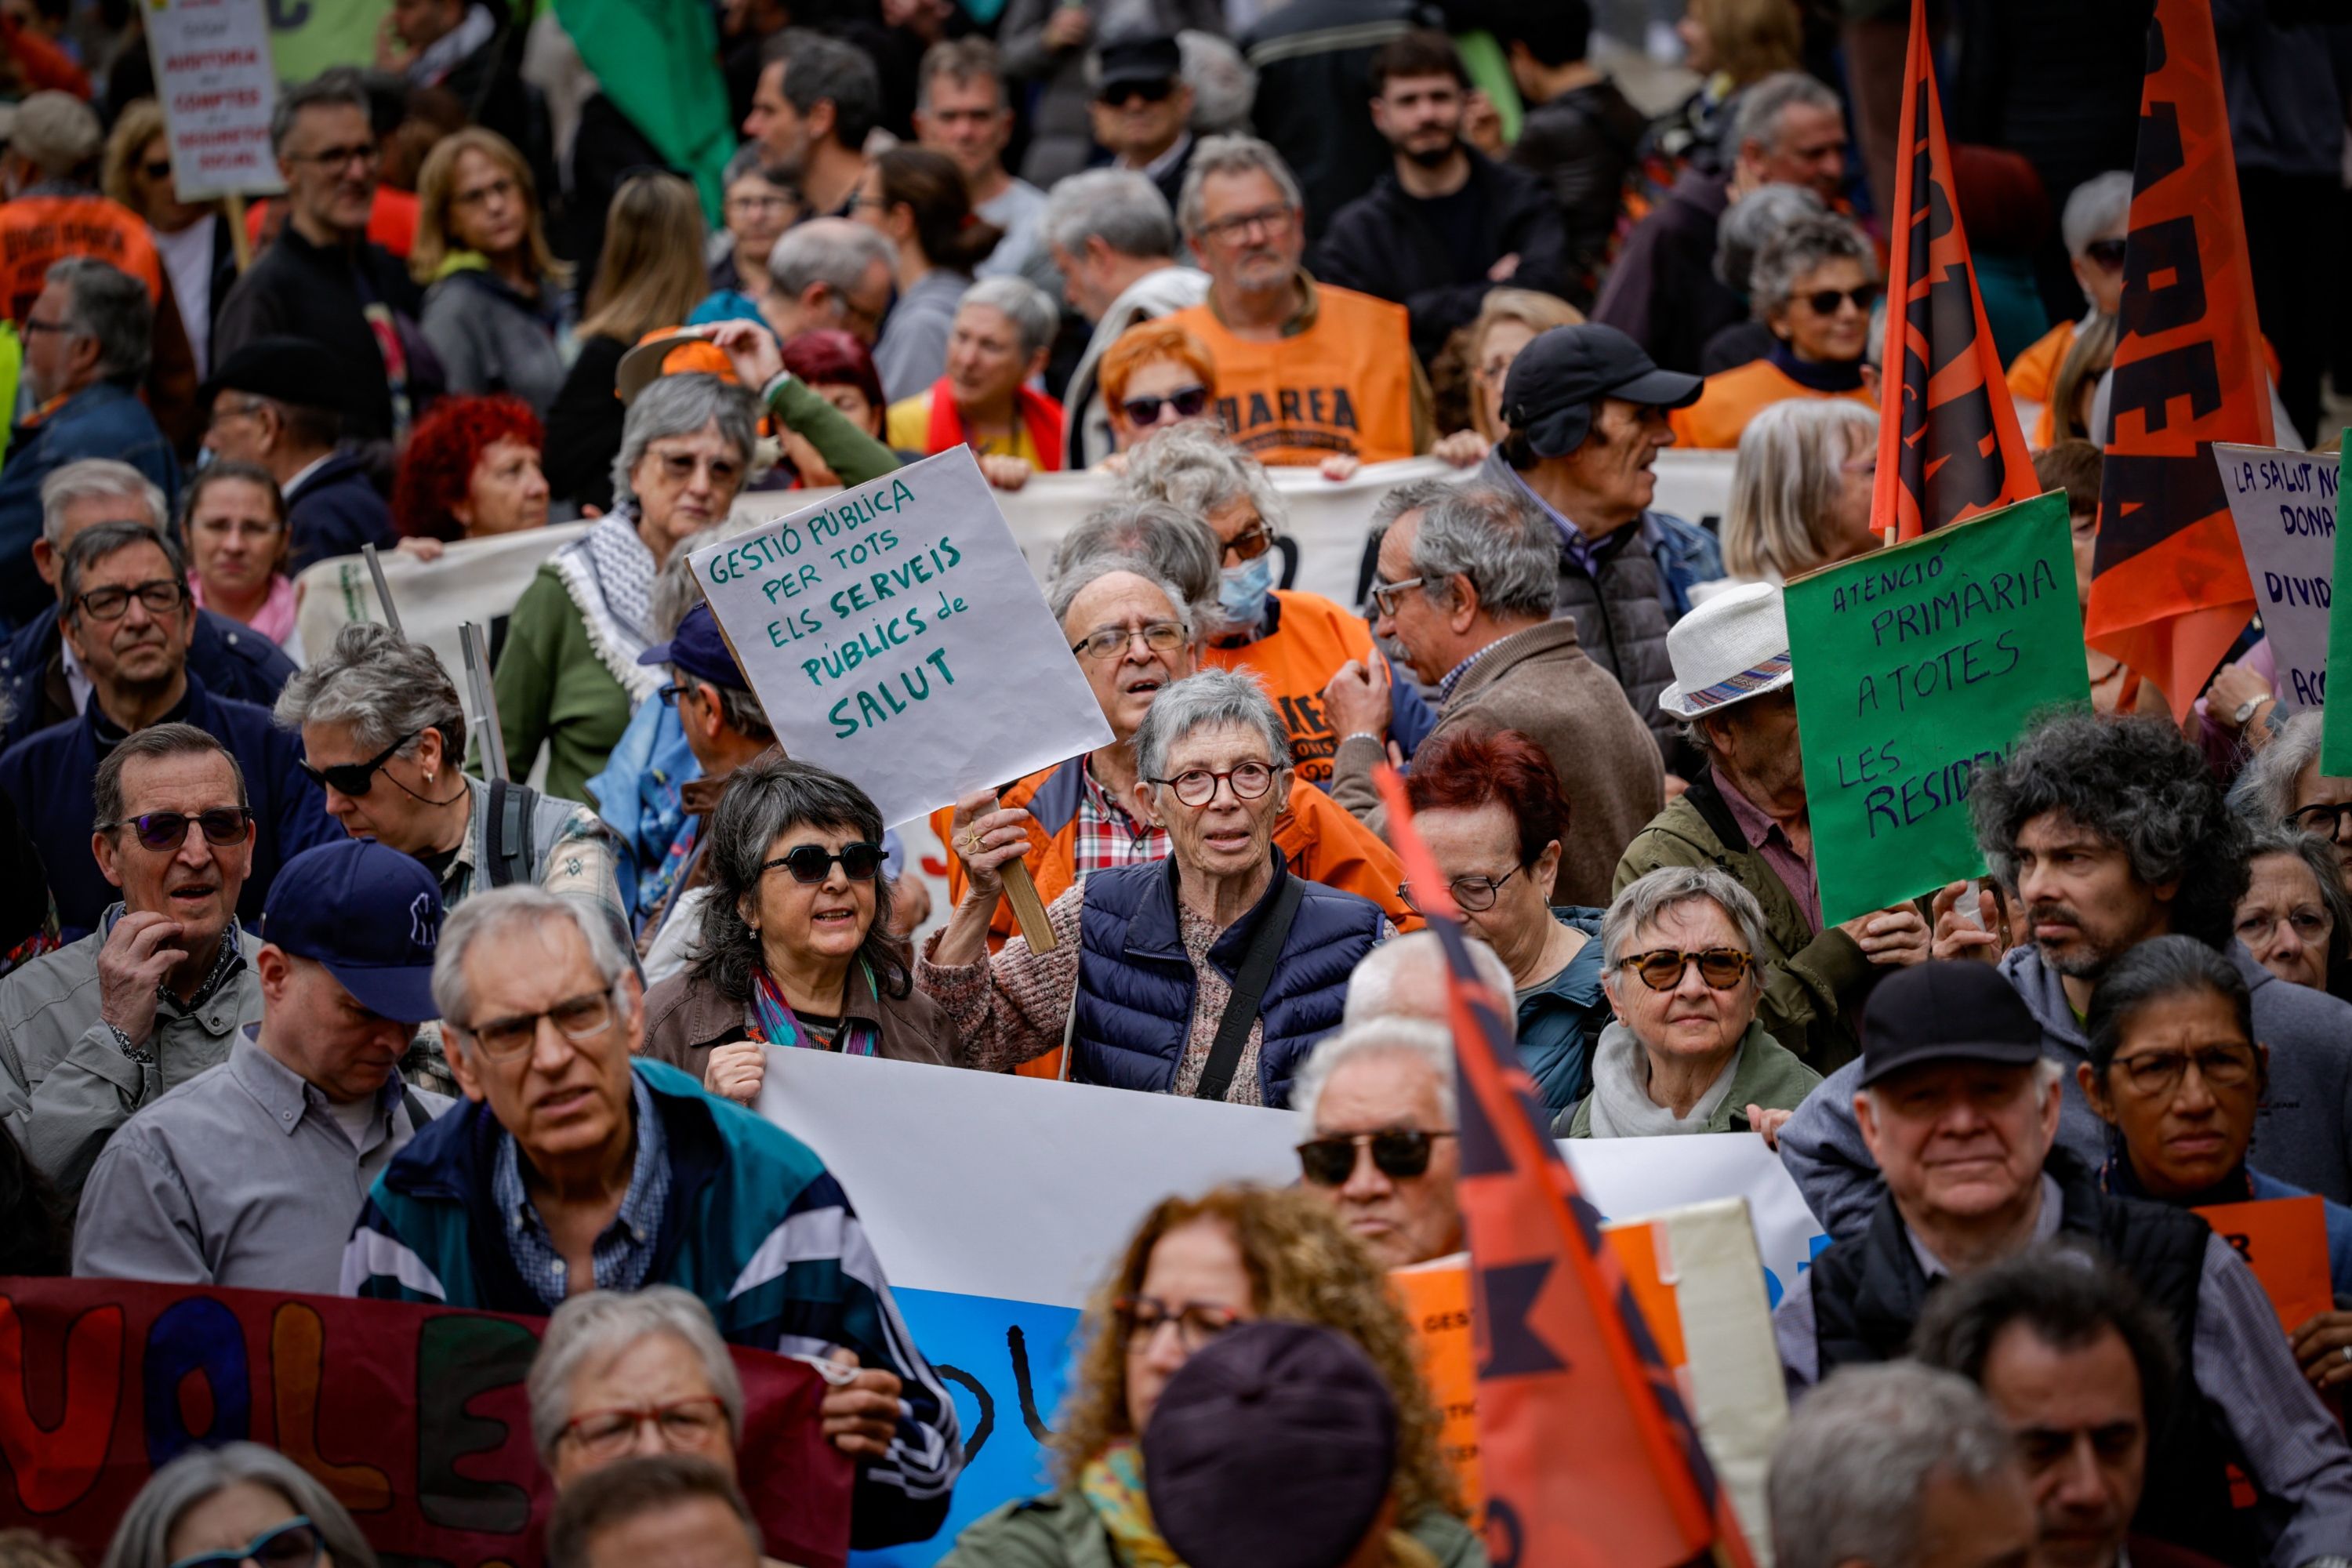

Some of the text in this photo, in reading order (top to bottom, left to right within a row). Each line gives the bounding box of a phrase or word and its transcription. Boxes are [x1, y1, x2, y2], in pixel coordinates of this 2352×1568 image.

[2234, 462, 2256, 493] LA
[2260, 460, 2312, 493] SALUT
[710, 479, 915, 584] GESTIÓ PÚBLICA
[2280, 505, 2337, 538] DONA
[762, 529, 898, 604] PER TOTS
[767, 536, 961, 648] ELS SERVEIS
[1833, 543, 1949, 614] ATENCIÓ
[1871, 558, 2057, 647] PRIMÀRIA
[2265, 572, 2332, 608] DIVID
[801, 590, 968, 686] PÚBLICS de
[1859, 630, 2020, 717] A TOTES
[829, 648, 955, 739] SALUT
[1838, 739, 1900, 788] LES
